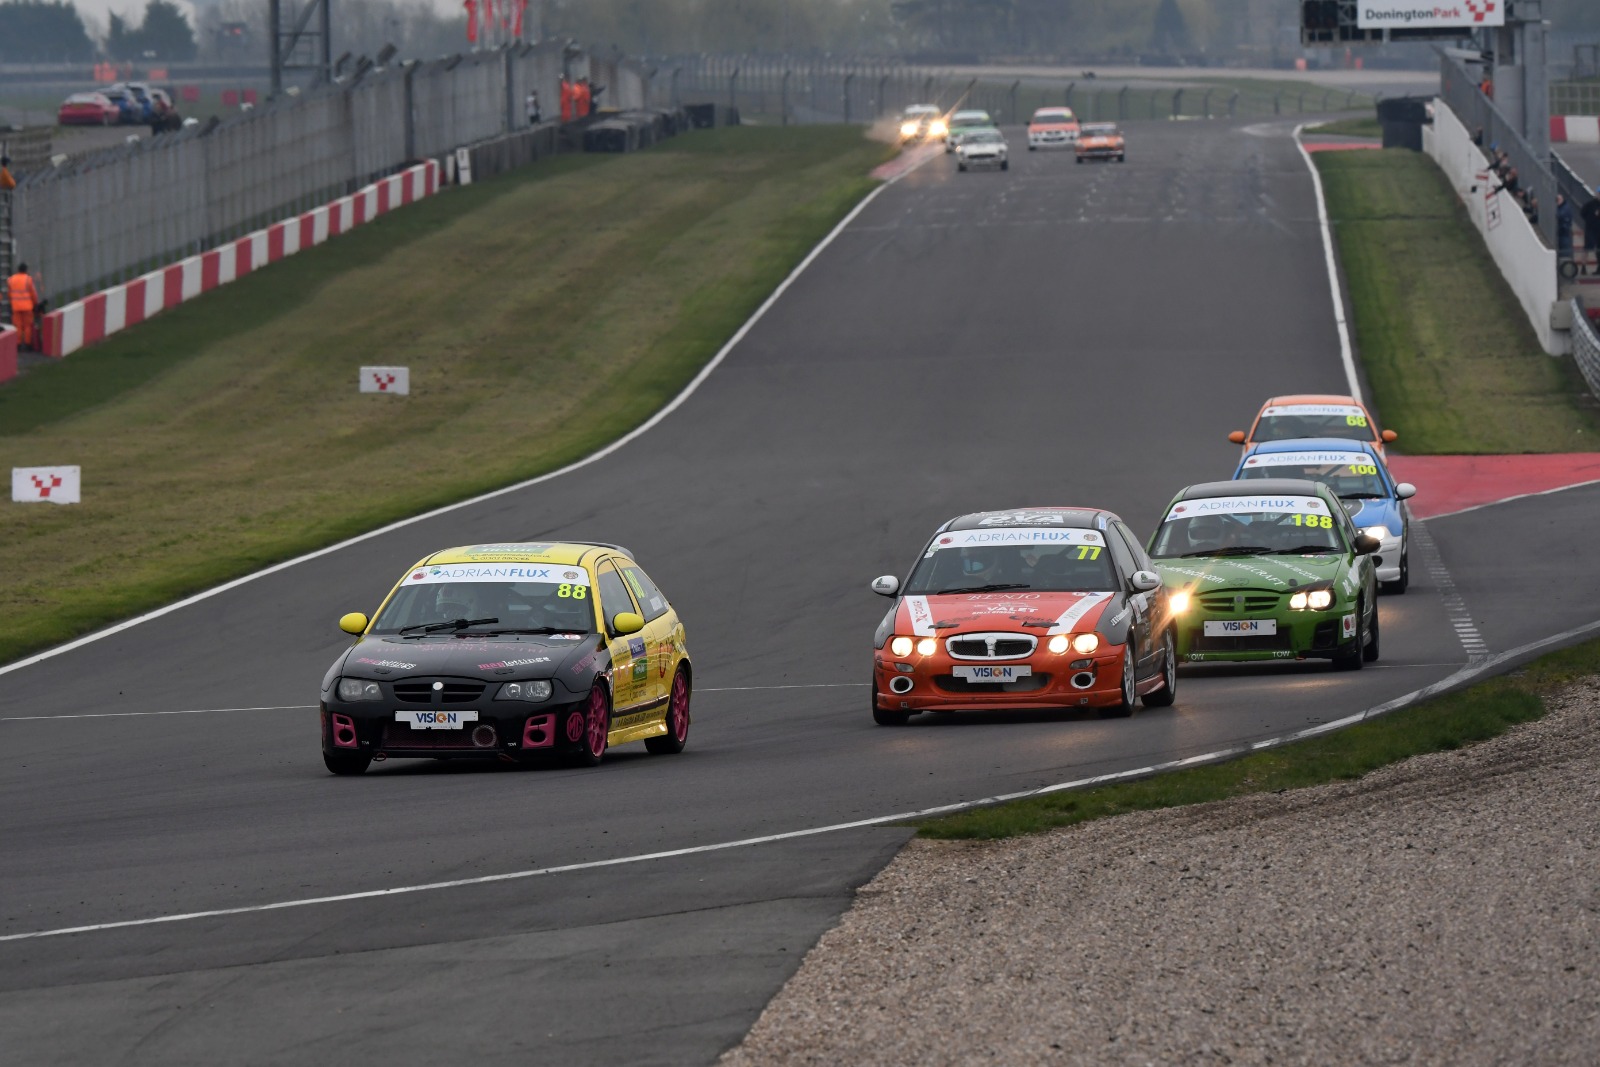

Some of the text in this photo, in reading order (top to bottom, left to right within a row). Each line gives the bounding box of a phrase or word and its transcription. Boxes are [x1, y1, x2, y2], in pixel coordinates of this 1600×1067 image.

[1346, 415, 1367, 427] 68
[1349, 464, 1377, 475] 100
[1292, 513, 1333, 529] 188
[1076, 545, 1102, 560] 77
[557, 583, 587, 600] 88
[1222, 621, 1258, 631] VISION
[1272, 650, 1291, 658] TOW
[973, 667, 1011, 677] VISION
[416, 712, 456, 723] VISION
